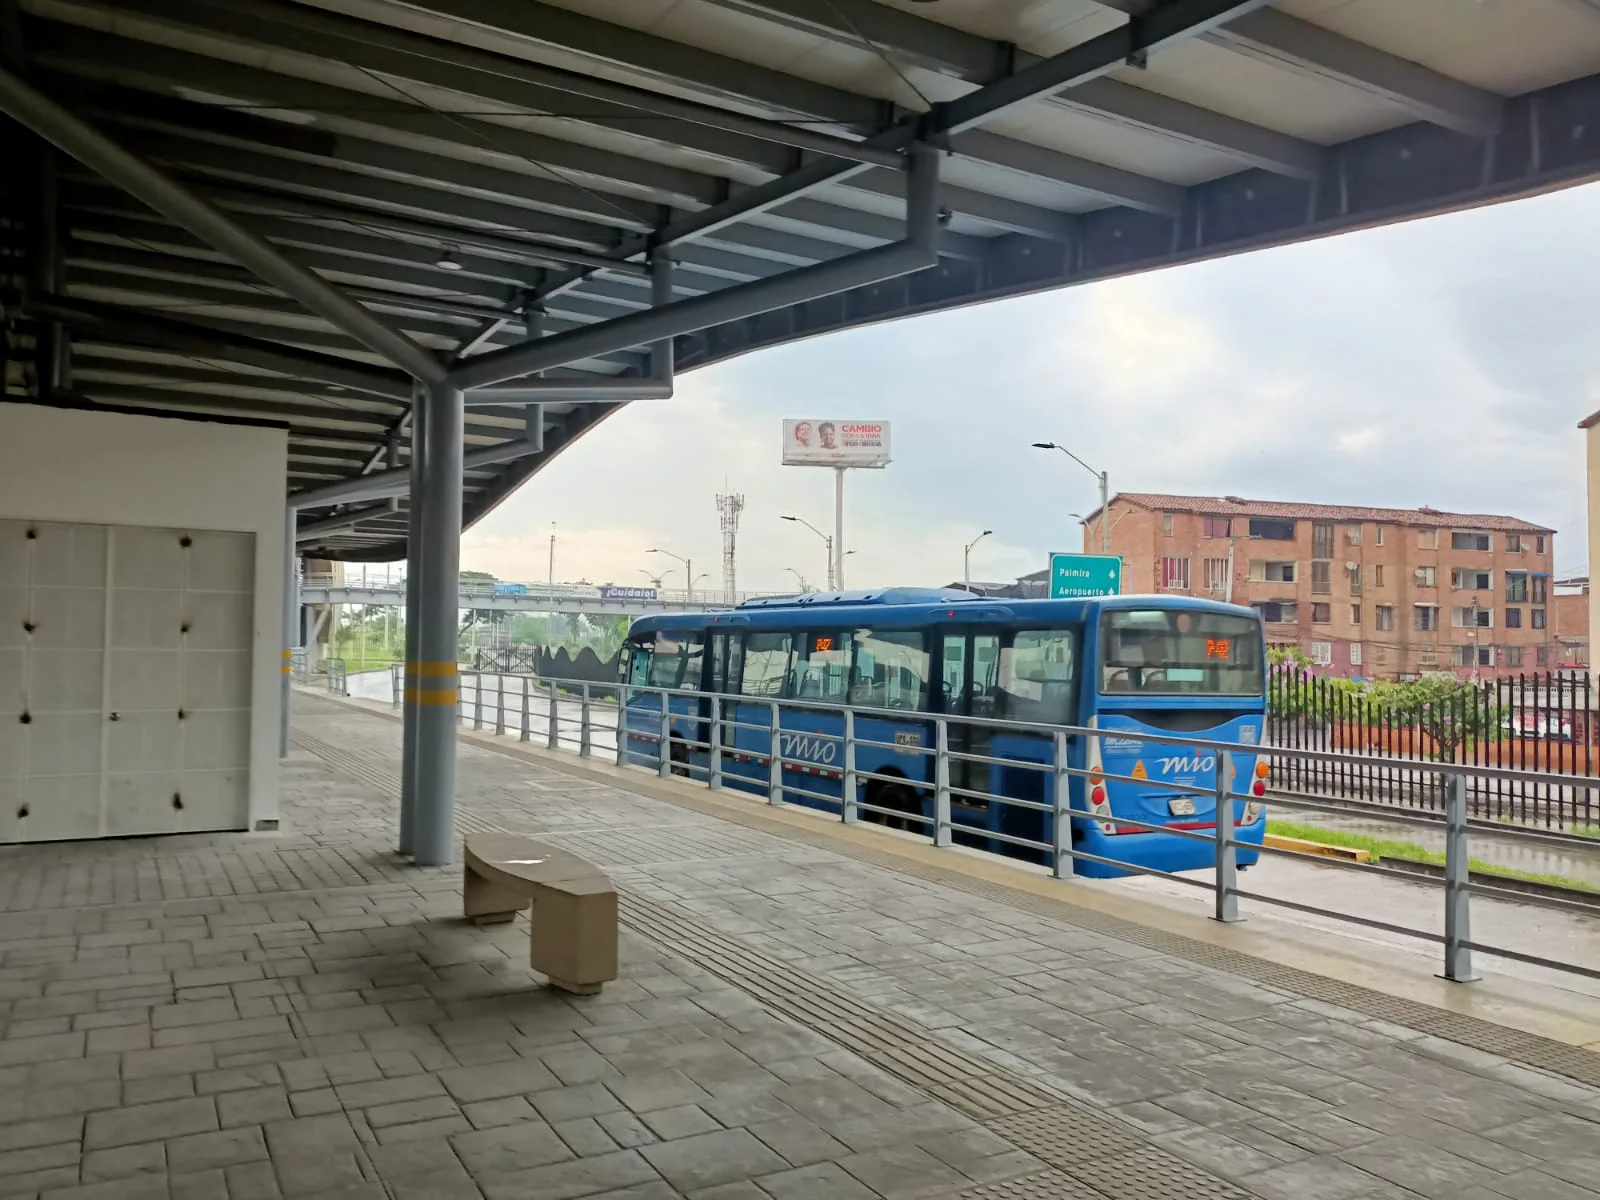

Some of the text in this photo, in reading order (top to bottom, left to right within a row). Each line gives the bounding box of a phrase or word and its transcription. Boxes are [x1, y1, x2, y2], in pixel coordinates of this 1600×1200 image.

[841, 424, 882, 433] CAMBIO
[1059, 568, 1091, 578] Palmira
[1058, 586, 1105, 597] Aeropuerto
